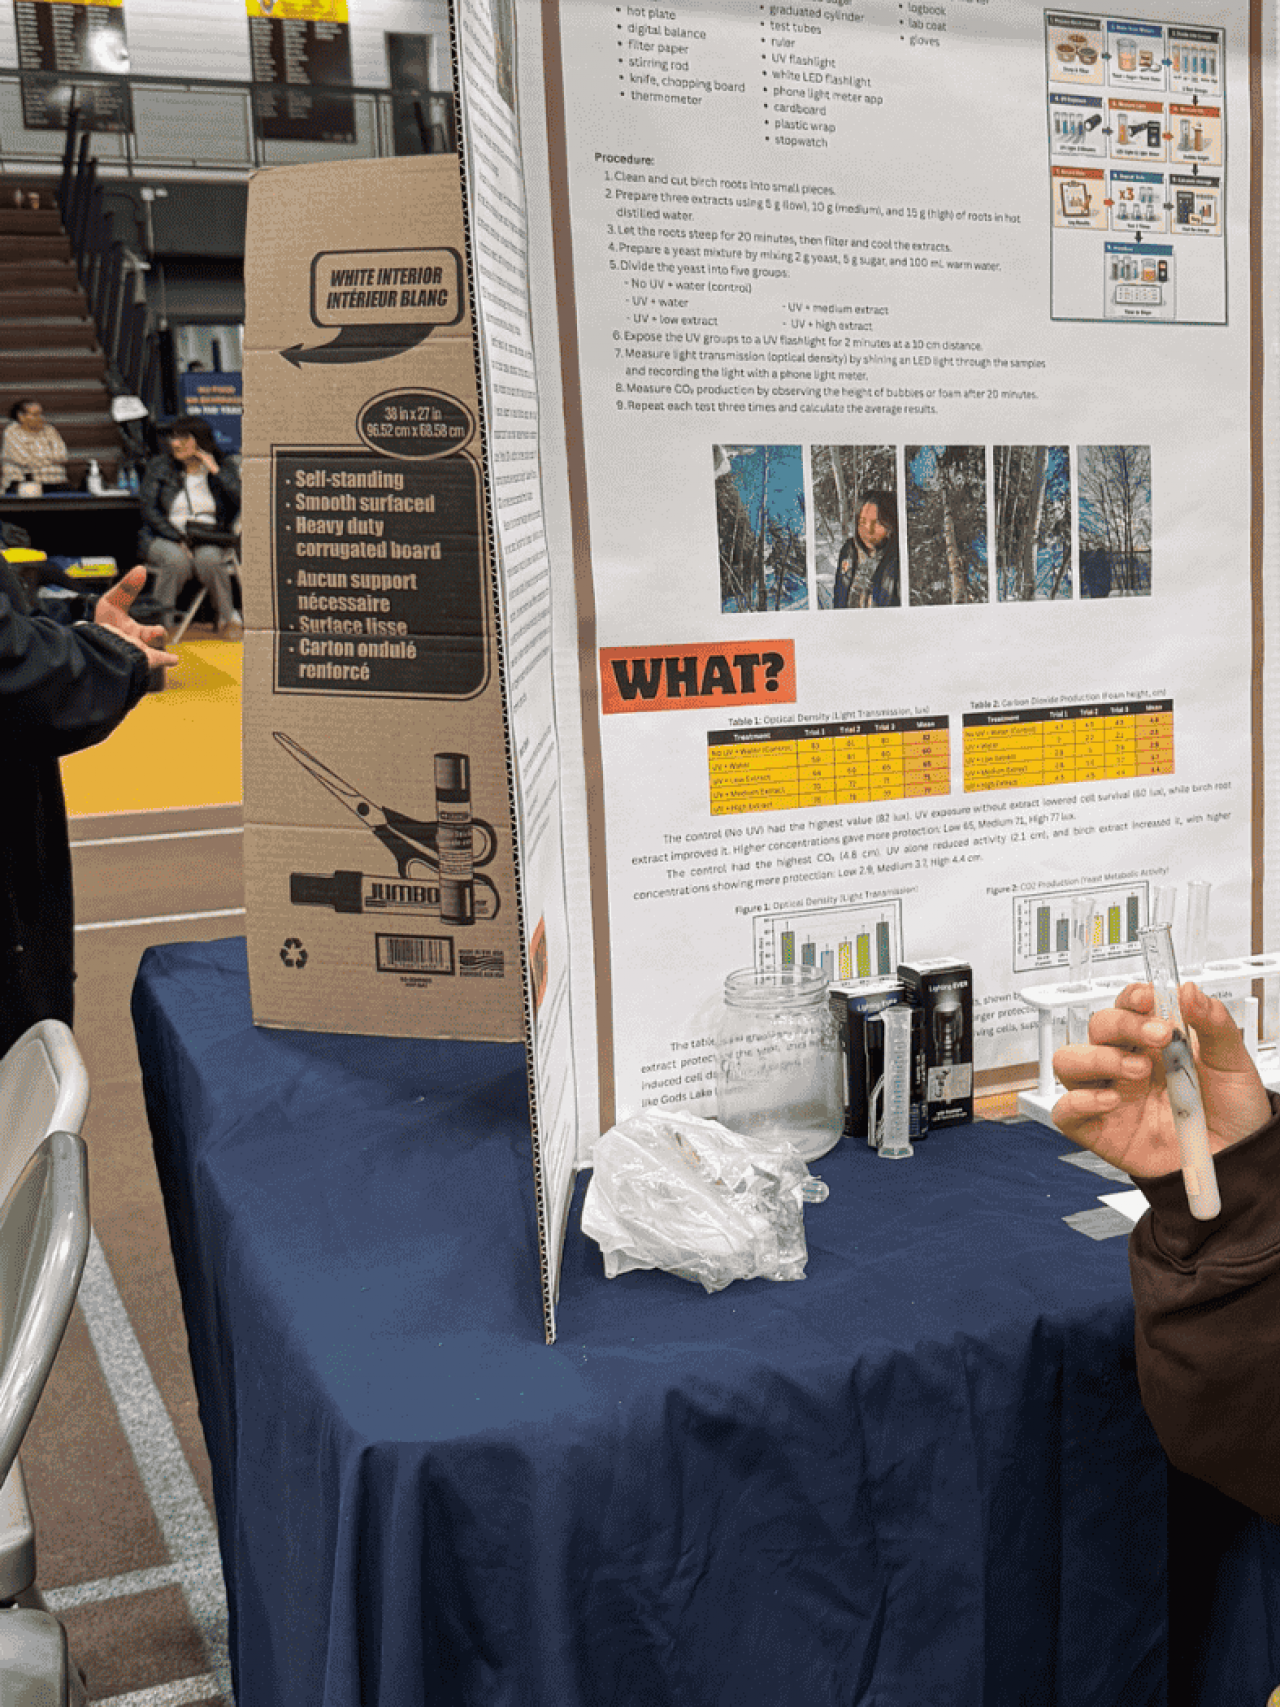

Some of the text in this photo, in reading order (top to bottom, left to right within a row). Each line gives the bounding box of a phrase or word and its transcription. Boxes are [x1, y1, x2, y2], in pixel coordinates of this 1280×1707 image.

[626, 4, 676, 21] hot plate
[769, 3, 865, 24] graduated cylinder
[907, 2, 946, 17] logbook
[627, 23, 706, 39] digital balance
[769, 20, 821, 34] test tubes
[908, 17, 946, 31] lab coat
[627, 38, 689, 56] filter paper
[770, 37, 795, 47] ruler
[909, 34, 940, 48] gloves
[628, 56, 689, 72] stirring rod
[771, 52, 836, 70] UV flashlight
[629, 72, 745, 93] knife, chopping board
[771, 69, 871, 89] white LED flashlight
[630, 90, 702, 105] thermometer
[772, 85, 883, 106] phone light meter app
[773, 102, 826, 115] cardboard
[774, 118, 836, 133] plastic wrap
[774, 135, 828, 148] stopwatch
[594, 152, 654, 166] Procedure:
[613, 170, 645, 183] Clean
[647, 173, 668, 184] and
[670, 175, 688, 186] cut
[690, 175, 717, 188] birch
[719, 178, 748, 190] roots
[749, 180, 771, 191] into
[771, 182, 800, 193] small
[801, 185, 836, 197] pieces.
[330, 267, 443, 287] WHITE INTERIOR
[326, 287, 449, 310] INTÉRIEUR BLANC
[384, 405, 398, 421] 38
[399, 406, 409, 420] in
[417, 406, 430, 420] 27
[431, 406, 442, 420] in
[366, 424, 394, 438] 96.52
[395, 426, 410, 438] cm
[449, 426, 466, 438] cm
[295, 470, 404, 491] Self-standing
[295, 493, 436, 513] Smooth surfaced
[295, 516, 385, 537] Heavy duty
[296, 541, 442, 560] corrugated board
[296, 569, 418, 591] Aucun support
[298, 592, 391, 613] nécessaire
[299, 615, 409, 636] Surface lisse
[299, 637, 417, 660] Carton ondulé
[299, 661, 371, 681] renforcé
[611, 652, 785, 701] WHAT?
